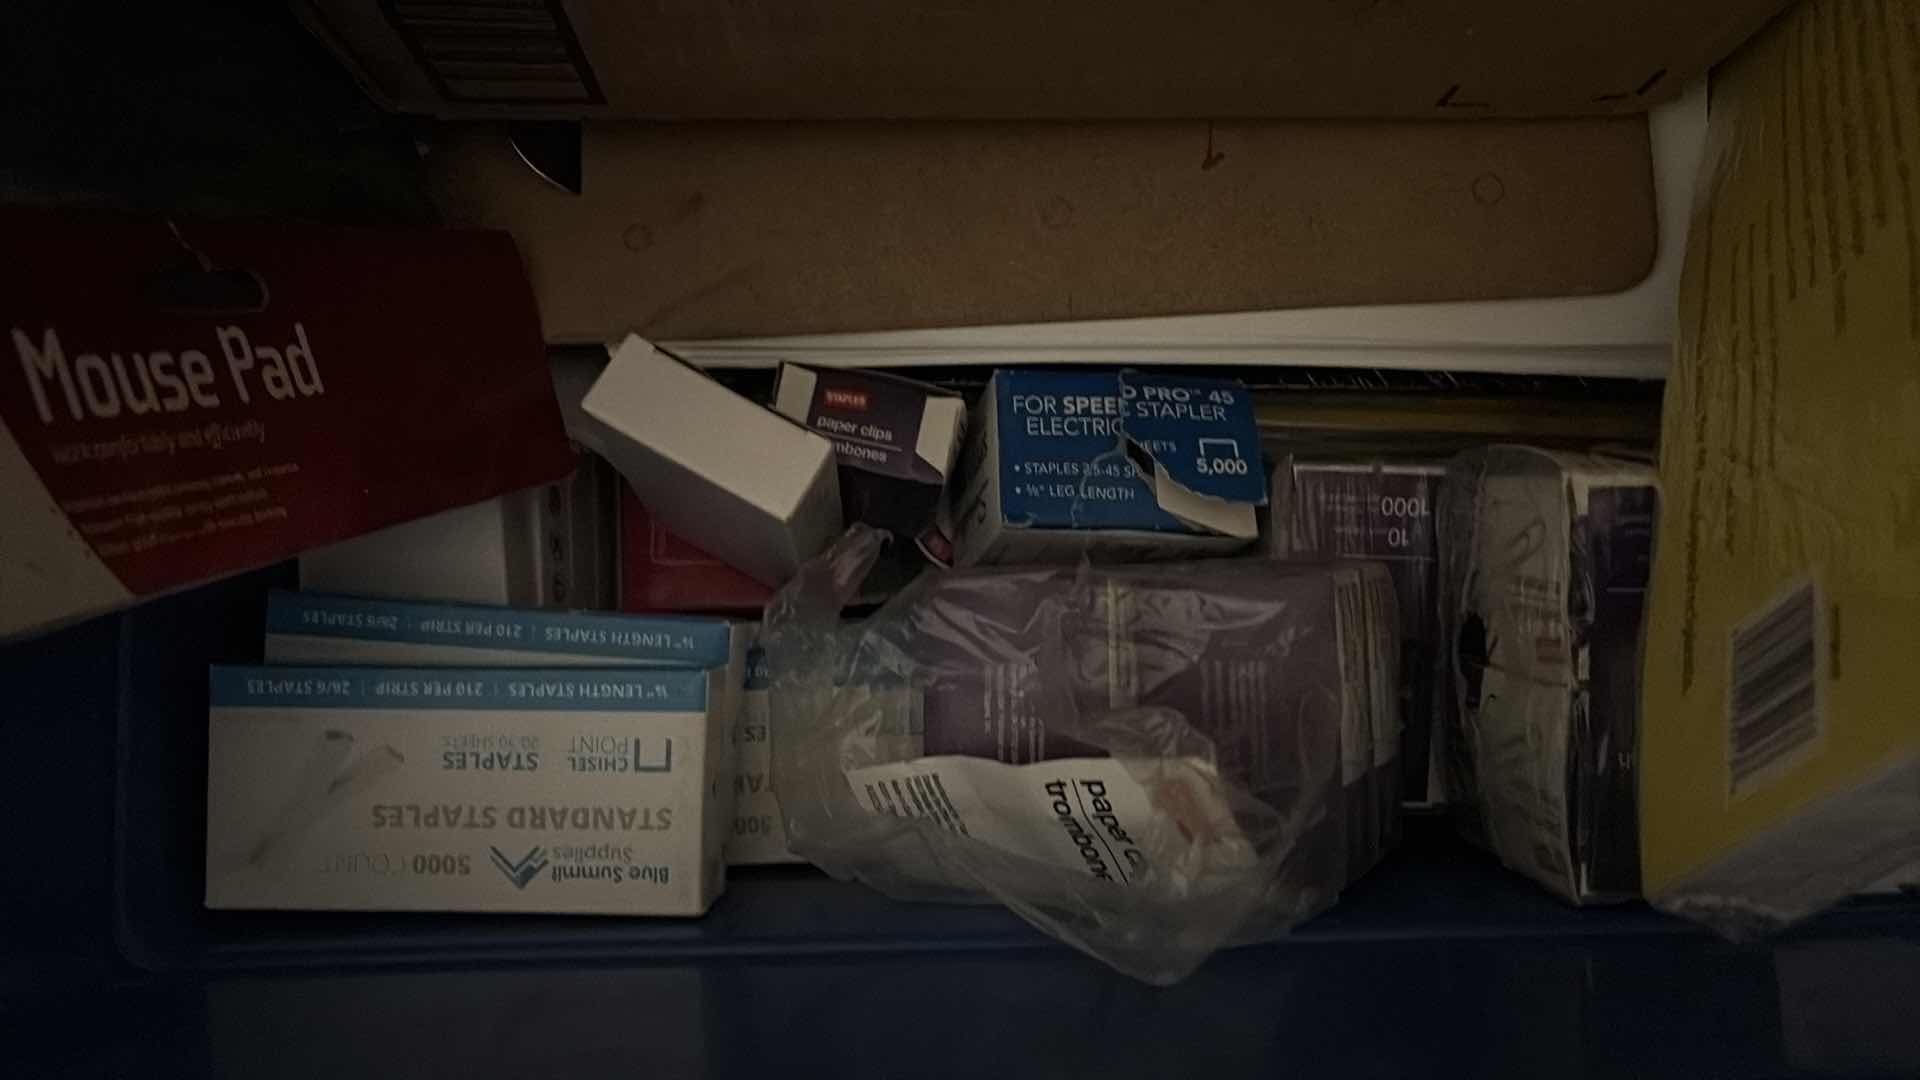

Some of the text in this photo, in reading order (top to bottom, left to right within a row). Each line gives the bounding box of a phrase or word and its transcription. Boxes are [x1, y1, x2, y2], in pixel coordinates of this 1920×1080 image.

[9, 320, 326, 423] Mouse Pad
[1012, 394, 1057, 415] FOR
[1208, 390, 1235, 406] 45
[1026, 401, 1227, 437] ELECTRIC STAPLER
[815, 416, 893, 441] paper clips
[1024, 461, 1080, 475] STAPLES
[1195, 456, 1248, 475] 5,000
[1048, 484, 1076, 498] LEG
[1080, 485, 1136, 500] LENGTH
[1381, 496, 1430, 518] 1000
[1387, 527, 1409, 547] 10
[302, 609, 364, 627] STAPLES
[420, 616, 462, 634] STRIP
[464, 621, 495, 637] PER
[497, 623, 523, 640] 210
[544, 627, 608, 643] STAPLES
[611, 631, 672, 648] LENGTH
[247, 679, 313, 697] STAPLES
[375, 680, 419, 697] STRIP
[423, 681, 453, 697] PER
[456, 681, 483, 697] 210
[508, 682, 575, 697] STAPLES
[578, 683, 643, 699] LENGTH
[568, 736, 629, 754] POINT
[441, 751, 540, 770] STAPLES
[568, 755, 629, 772] CHISEL
[371, 803, 673, 832] STANDARD STAPLES
[1080, 780, 1135, 845] paper
[552, 842, 632, 863] Supplies
[411, 853, 472, 876] 5000
[551, 863, 670, 884] Blue Summit
